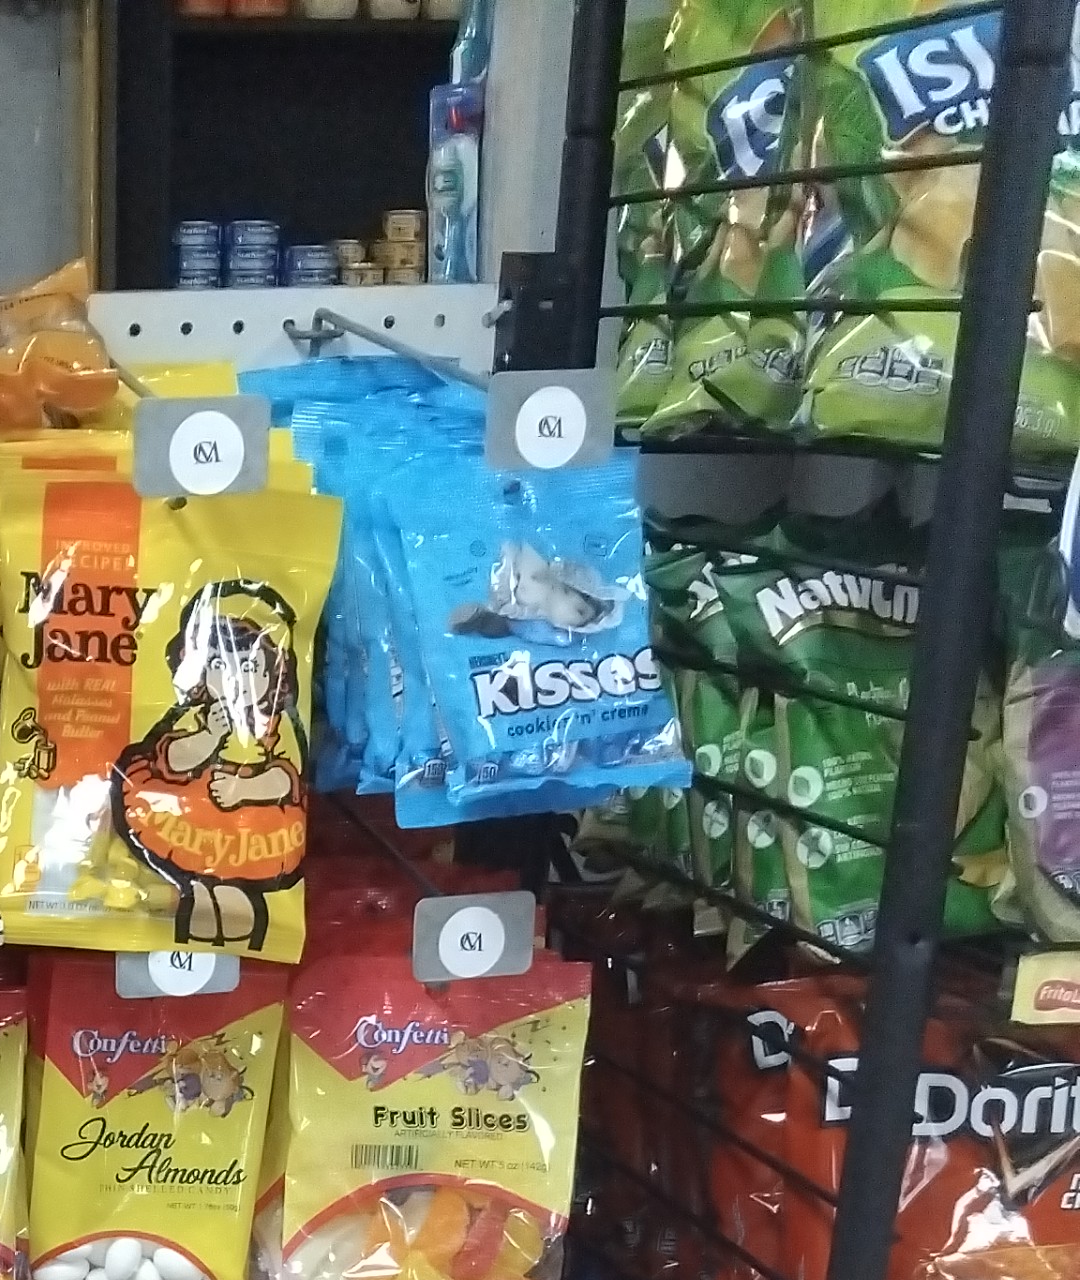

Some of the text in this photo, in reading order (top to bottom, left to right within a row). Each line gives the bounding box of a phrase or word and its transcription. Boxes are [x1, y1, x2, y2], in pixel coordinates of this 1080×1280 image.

[18, 571, 163, 632] Mary
[20, 621, 138, 669] Jane
[85, 678, 118, 692] REAL
[138, 809, 306, 867] Mary Jane
[71, 1027, 167, 1064] Confetti
[356, 1015, 452, 1053] Confetti
[372, 1105, 531, 1133] Fruit Slices
[911, 1073, 1080, 1138] Dori
[60, 1116, 176, 1161] Jordan
[115, 1147, 248, 1187] Almonds
[454, 1158, 477, 1170] NET
[479, 1159, 497, 1170] WT
